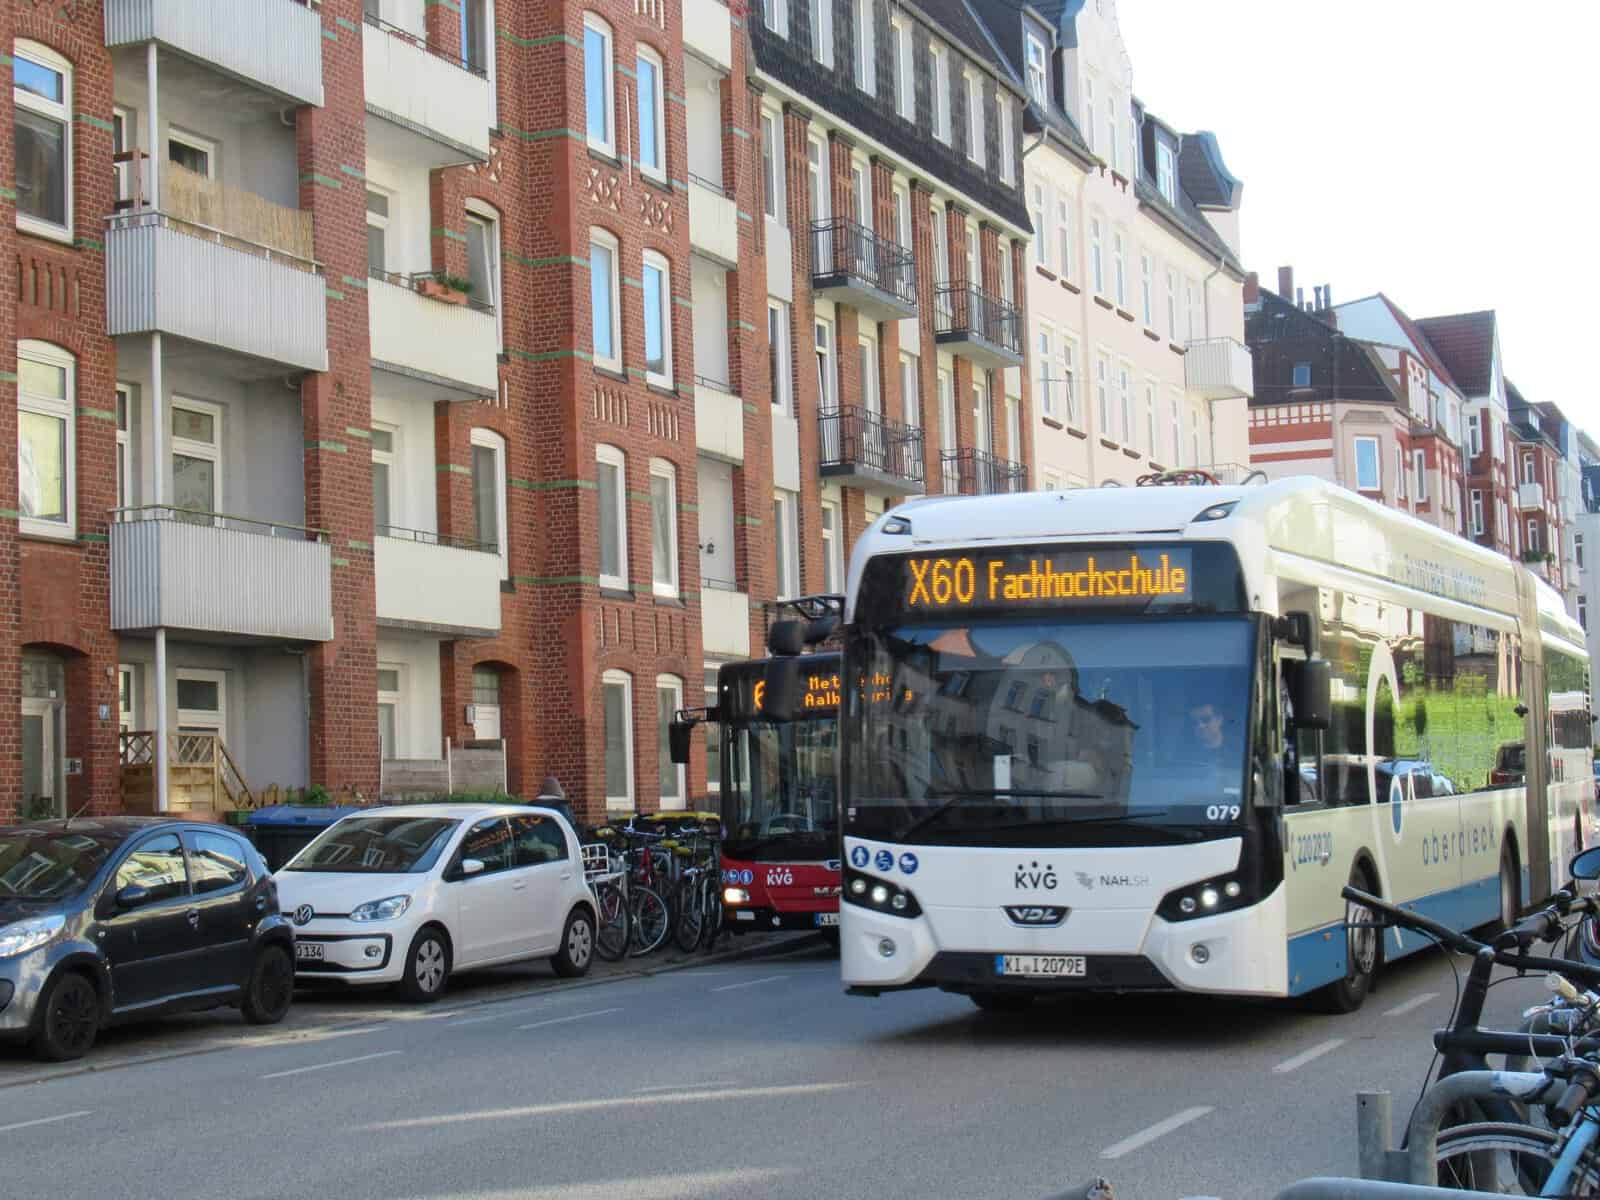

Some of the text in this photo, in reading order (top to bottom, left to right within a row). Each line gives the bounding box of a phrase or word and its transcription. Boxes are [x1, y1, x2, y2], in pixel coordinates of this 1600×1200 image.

[909, 554, 1185, 605] X60 Fachhochschule
[1206, 805, 1240, 820] 079
[767, 873, 793, 885] KVG
[1015, 872, 1057, 890] KVG
[1005, 957, 1021, 973] KI
